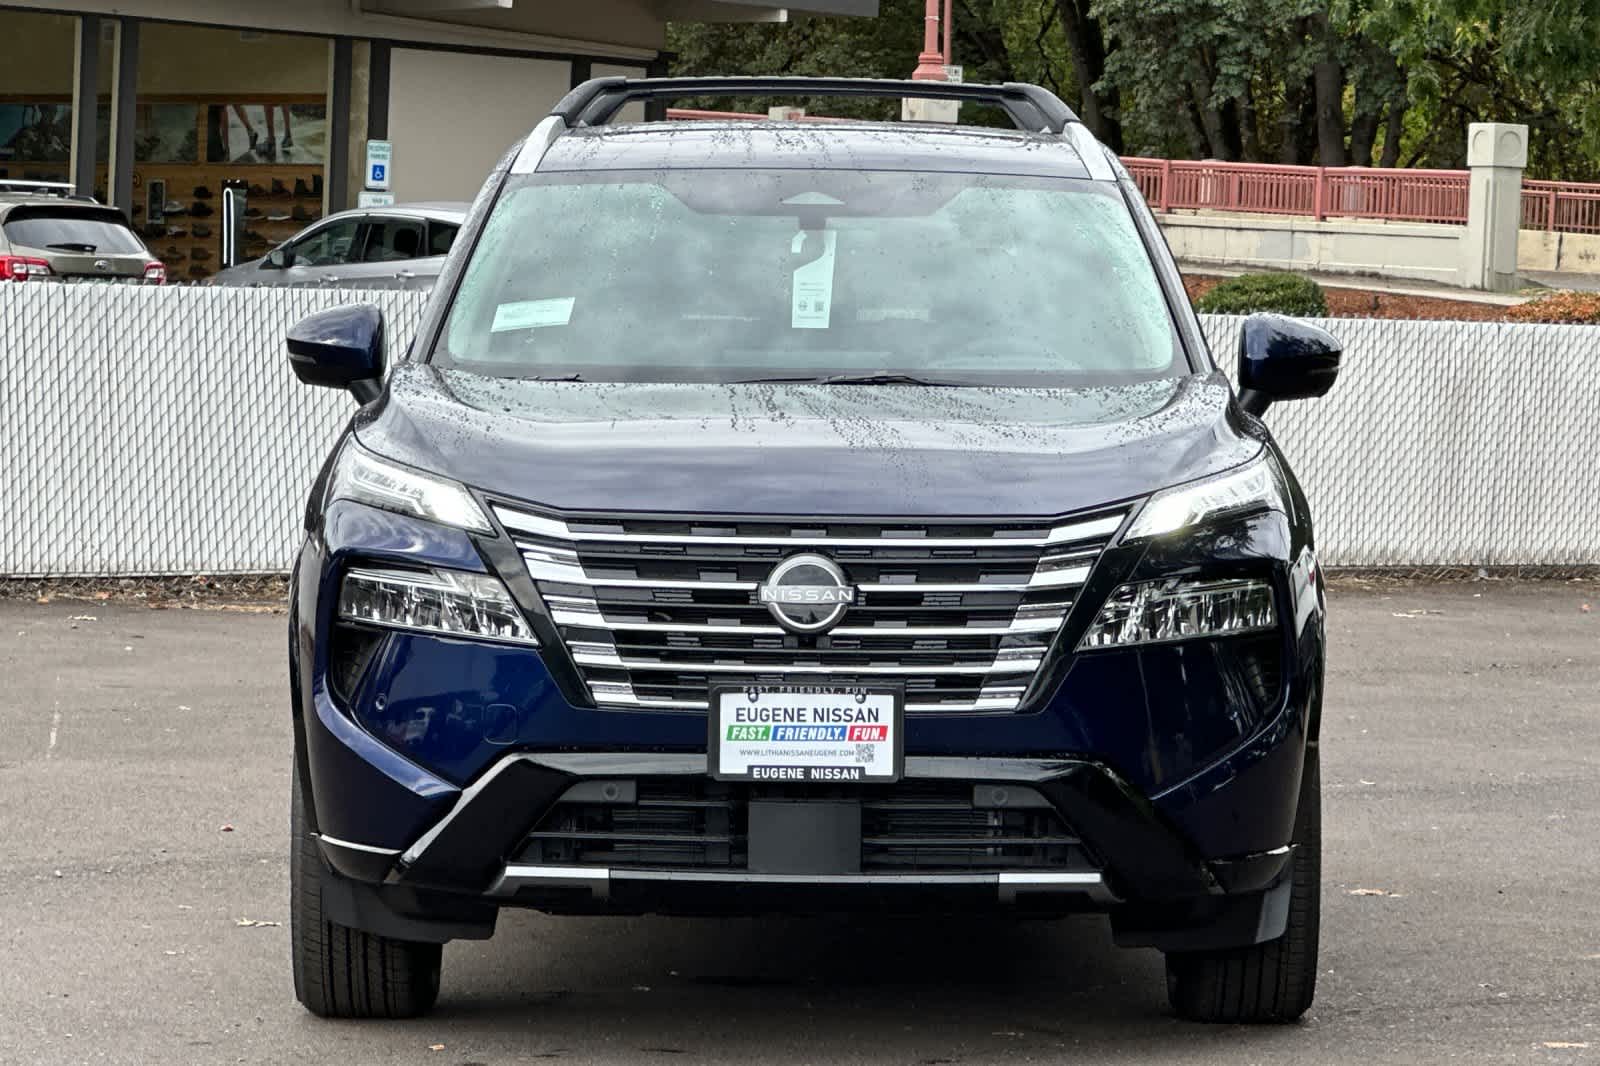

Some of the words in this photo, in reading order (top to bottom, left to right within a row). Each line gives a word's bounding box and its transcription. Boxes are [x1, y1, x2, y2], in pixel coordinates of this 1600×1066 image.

[763, 589, 853, 601] NISSAN
[735, 707, 807, 723] EUGENE
[813, 707, 880, 723] NISSAN
[731, 726, 767, 740] FAST.
[776, 727, 844, 740] FRIENDLY.
[853, 727, 885, 741] FUN.
[753, 767, 804, 779] EUGENE
[811, 768, 860, 780] NISSAN
